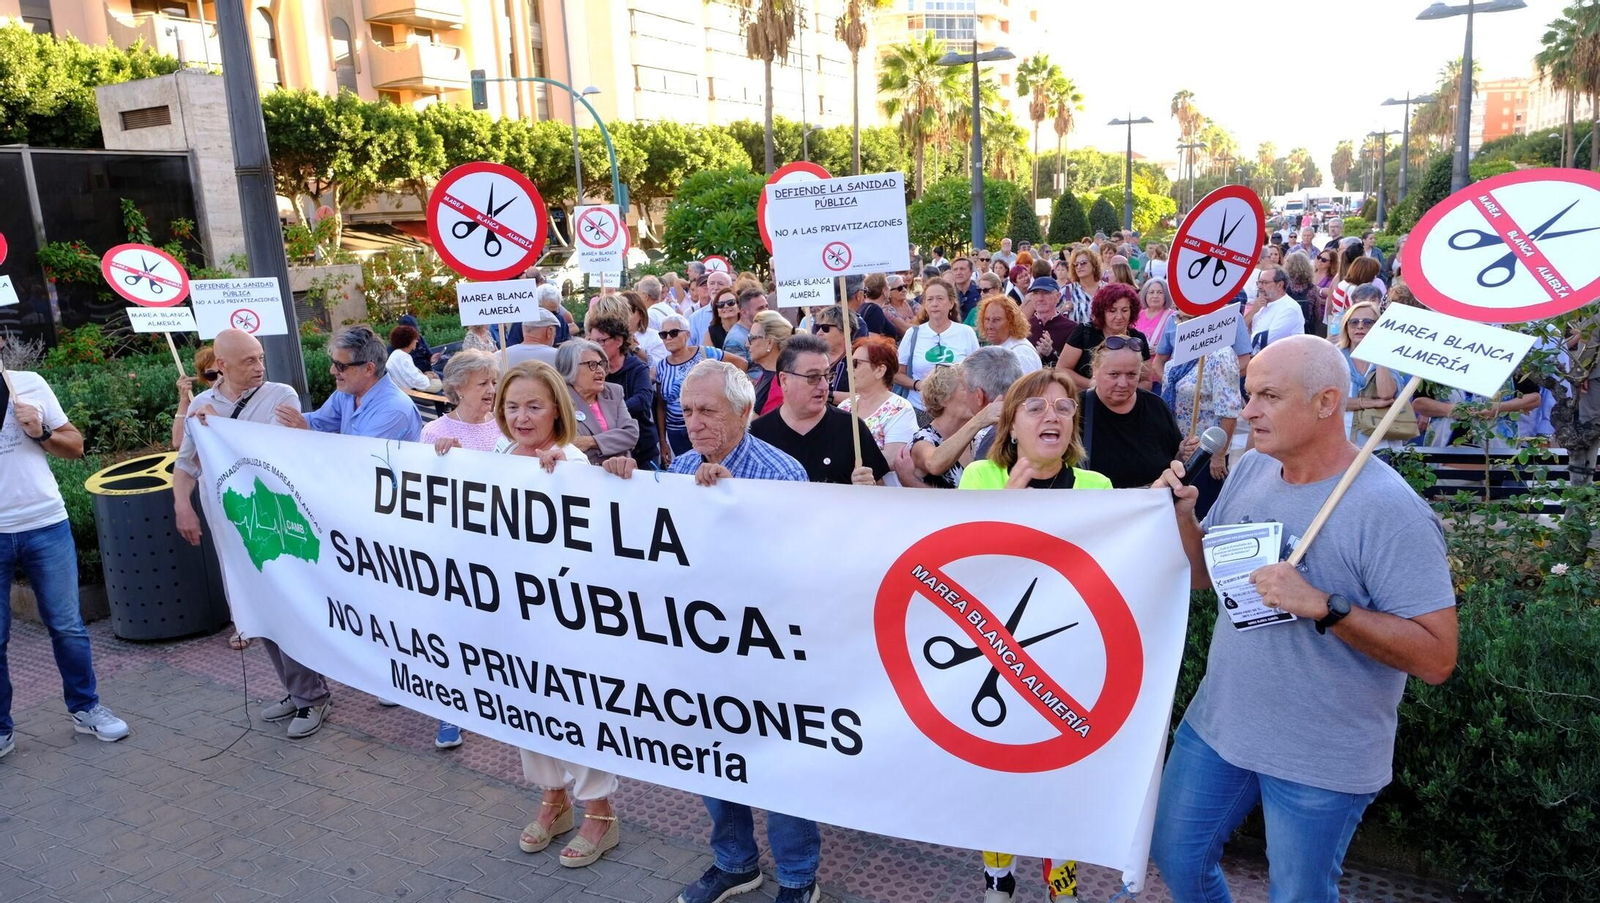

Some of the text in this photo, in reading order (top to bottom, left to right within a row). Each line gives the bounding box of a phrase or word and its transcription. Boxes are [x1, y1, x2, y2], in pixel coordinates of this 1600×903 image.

[774, 178, 896, 199] DEFIENDE LA SANIDAD
[815, 197, 858, 208] PÚBLICA
[443, 195, 533, 249] MAREA BLANCA ALMERÍA
[775, 229, 789, 237] NO
[801, 227, 818, 235] LAS
[820, 218, 903, 233] PRIVATIZACIONES
[1184, 238, 1201, 248] MAREA
[1209, 246, 1227, 257] BLANCA
[1477, 194, 1570, 299] MAREA BLANCA ALMERÍA
[461, 291, 534, 303] MAREA BLANCA
[790, 289, 820, 299] ALMERÍA
[479, 304, 520, 316] ALMERÍA
[1179, 316, 1236, 342] MAREA BLANCA
[1189, 333, 1223, 352] ALMERÍA
[1380, 318, 1515, 363] MAREA BLANCA
[1392, 345, 1470, 374] ALMERÍA
[263, 461, 270, 472] DE
[271, 466, 294, 493] MAREAS
[294, 492, 322, 534] BLANCAS
[374, 466, 691, 567] DEFIENDE LA
[330, 530, 808, 662] SANIDAD PÚBLICA:
[911, 564, 1092, 738] MAREA BLANCA ALMERÍA
[328, 596, 864, 756] NO A LAS PRIVATIZACIONES
[390, 658, 749, 785] Marea Blanca Almería
